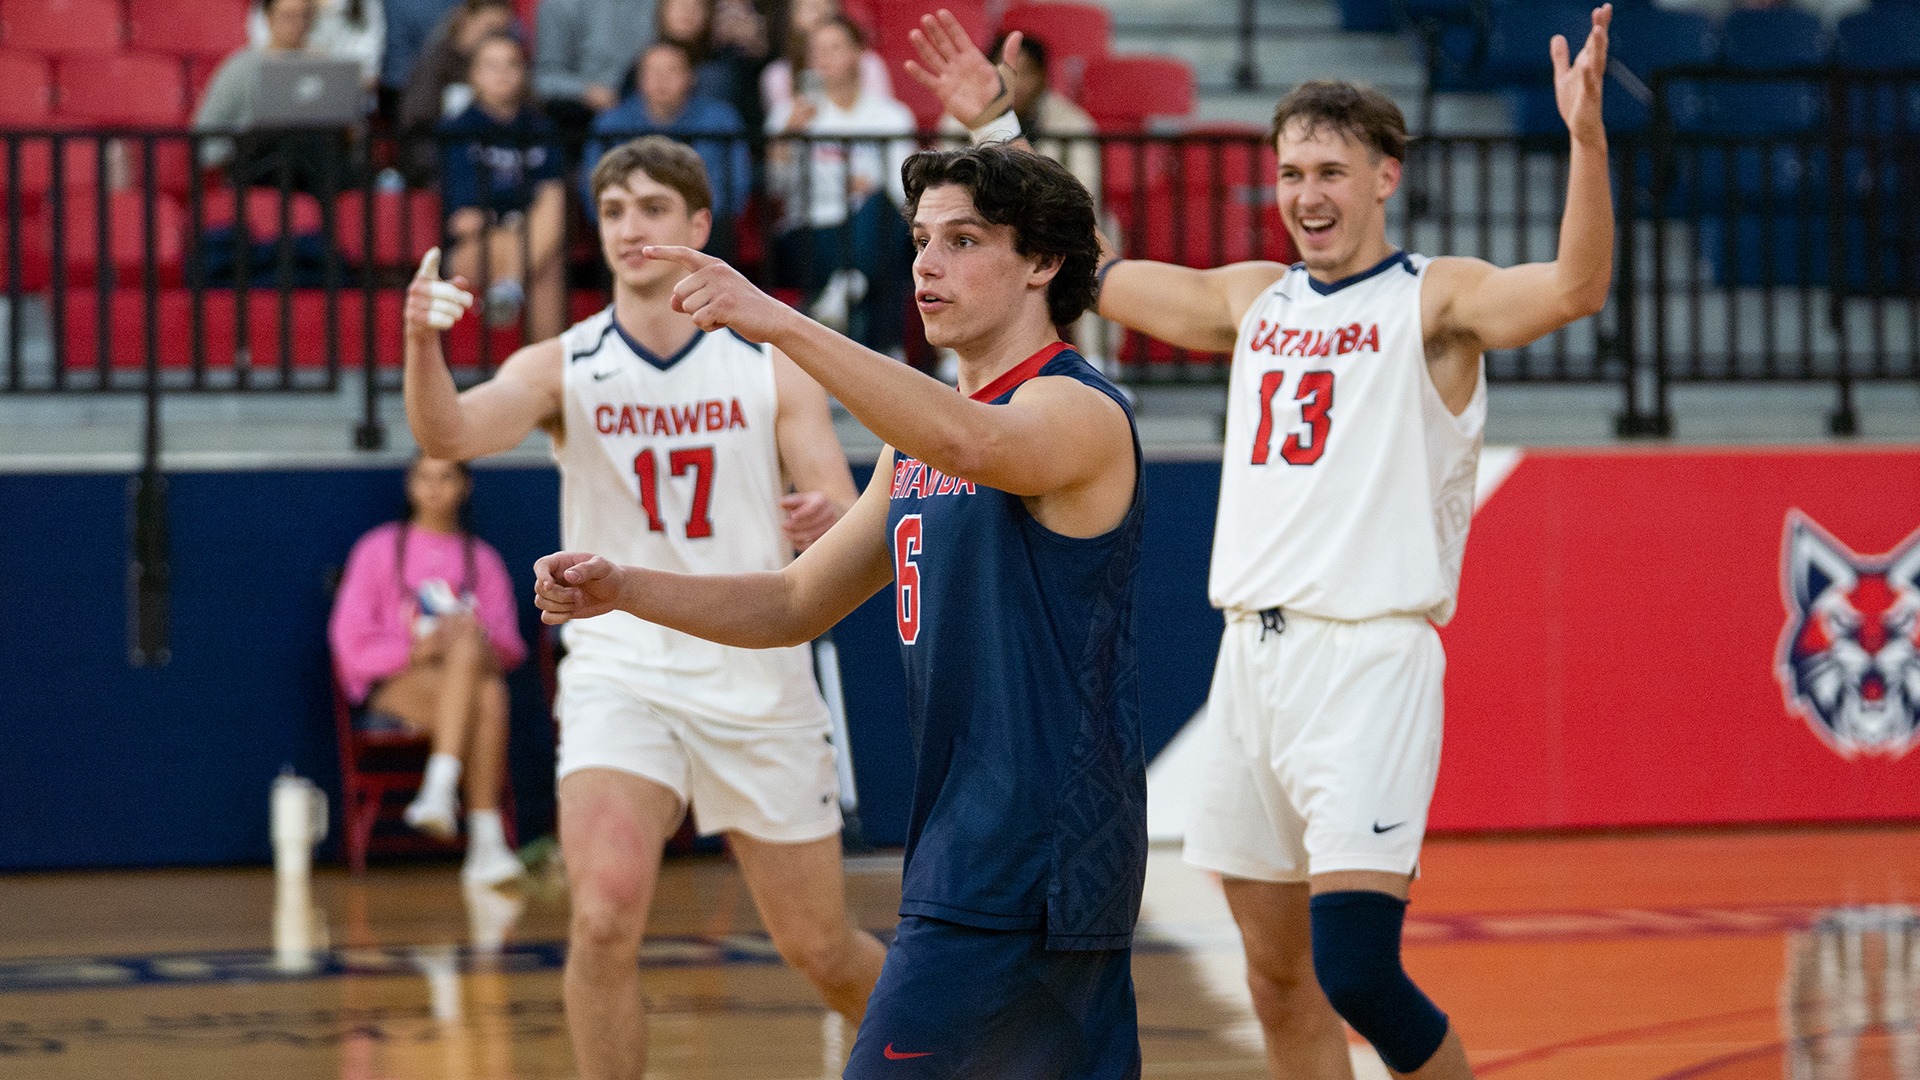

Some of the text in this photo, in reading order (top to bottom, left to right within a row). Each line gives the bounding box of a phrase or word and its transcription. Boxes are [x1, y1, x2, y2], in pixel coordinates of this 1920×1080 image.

[1250, 319, 1380, 358] CATAWBA
[594, 396, 749, 436] CATAWBA
[1250, 370, 1334, 466] 13
[633, 445, 716, 540] 17
[894, 513, 923, 646] 6
